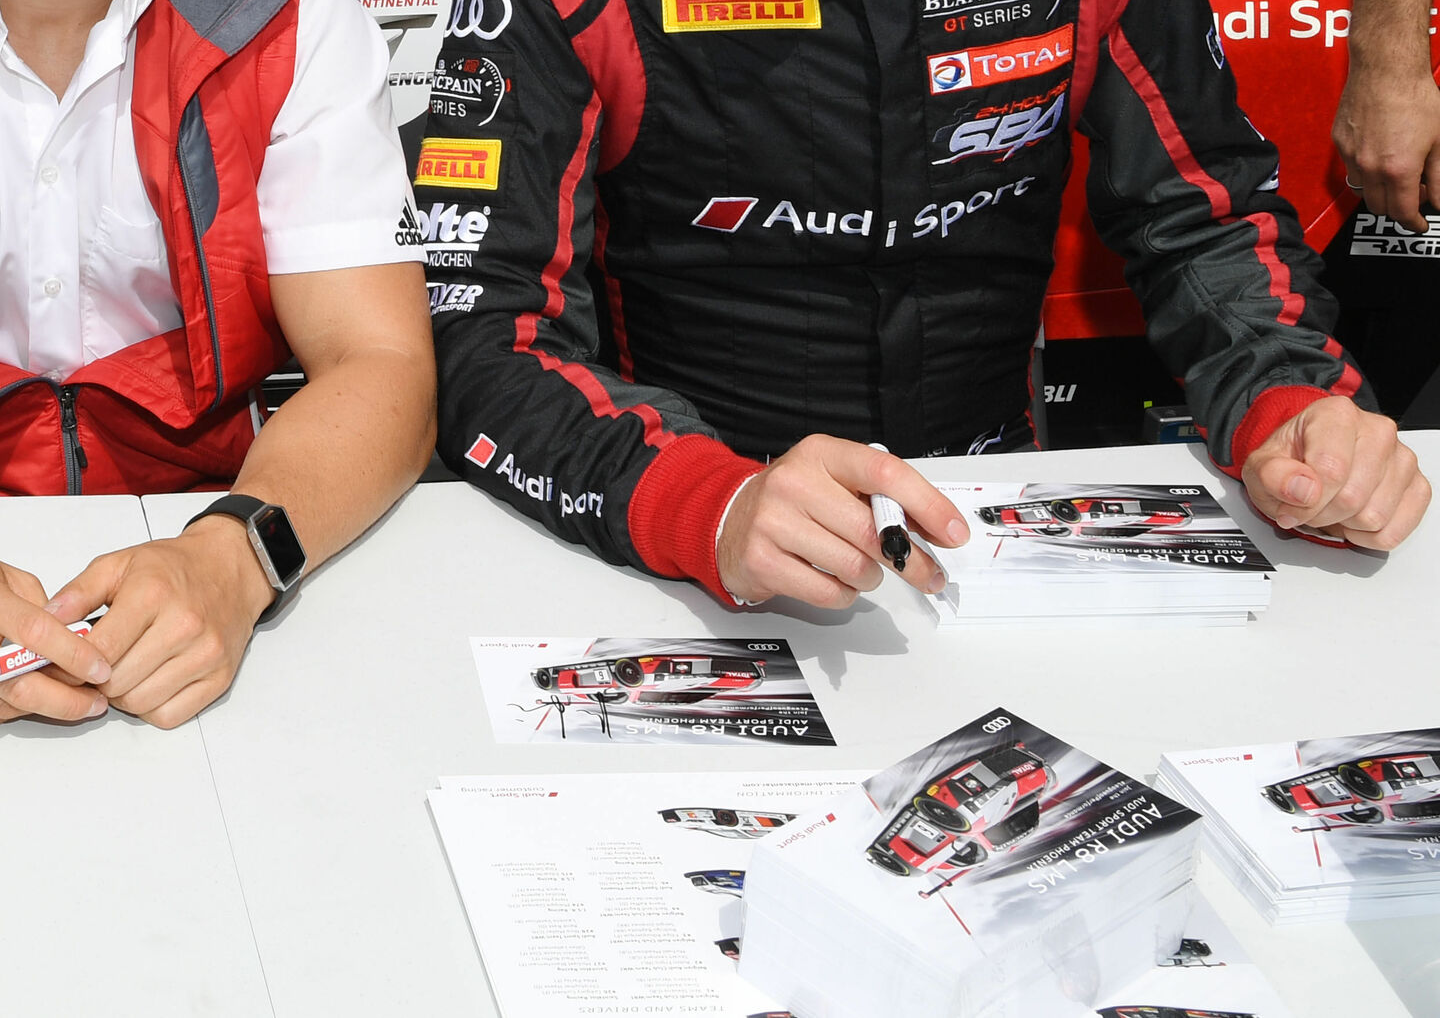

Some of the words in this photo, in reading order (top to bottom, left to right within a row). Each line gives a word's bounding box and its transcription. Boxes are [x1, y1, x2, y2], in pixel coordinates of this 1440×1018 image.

[944, 16, 968, 32] GT
[973, 3, 1032, 28] SERIES
[972, 42, 1070, 78] TOTAL
[762, 200, 897, 247] Audi
[913, 175, 1036, 239] Sport
[428, 252, 473, 269] KÜCHEN
[496, 453, 554, 503] Audi
[560, 491, 604, 518] port
[1074, 551, 1127, 563] LMS
[1138, 552, 1168, 563] R8
[1182, 553, 1246, 565] AUDI
[625, 724, 680, 735] LMS
[640, 716, 696, 724] PHOENIX
[691, 724, 726, 736] R8
[739, 724, 809, 736] AUDI
[1181, 757, 1214, 766] Sport
[1219, 755, 1241, 764] Audi
[1122, 794, 1147, 813] AUDI
[804, 818, 826, 838] Audi
[1093, 809, 1125, 829] SPORT
[1108, 802, 1163, 846] AUDI
[777, 830, 806, 849] Sport
[1068, 824, 1094, 845] TEAM
[1026, 839, 1067, 872] PHOENIX
[1073, 837, 1106, 866] R8
[1028, 860, 1070, 895] LMS
